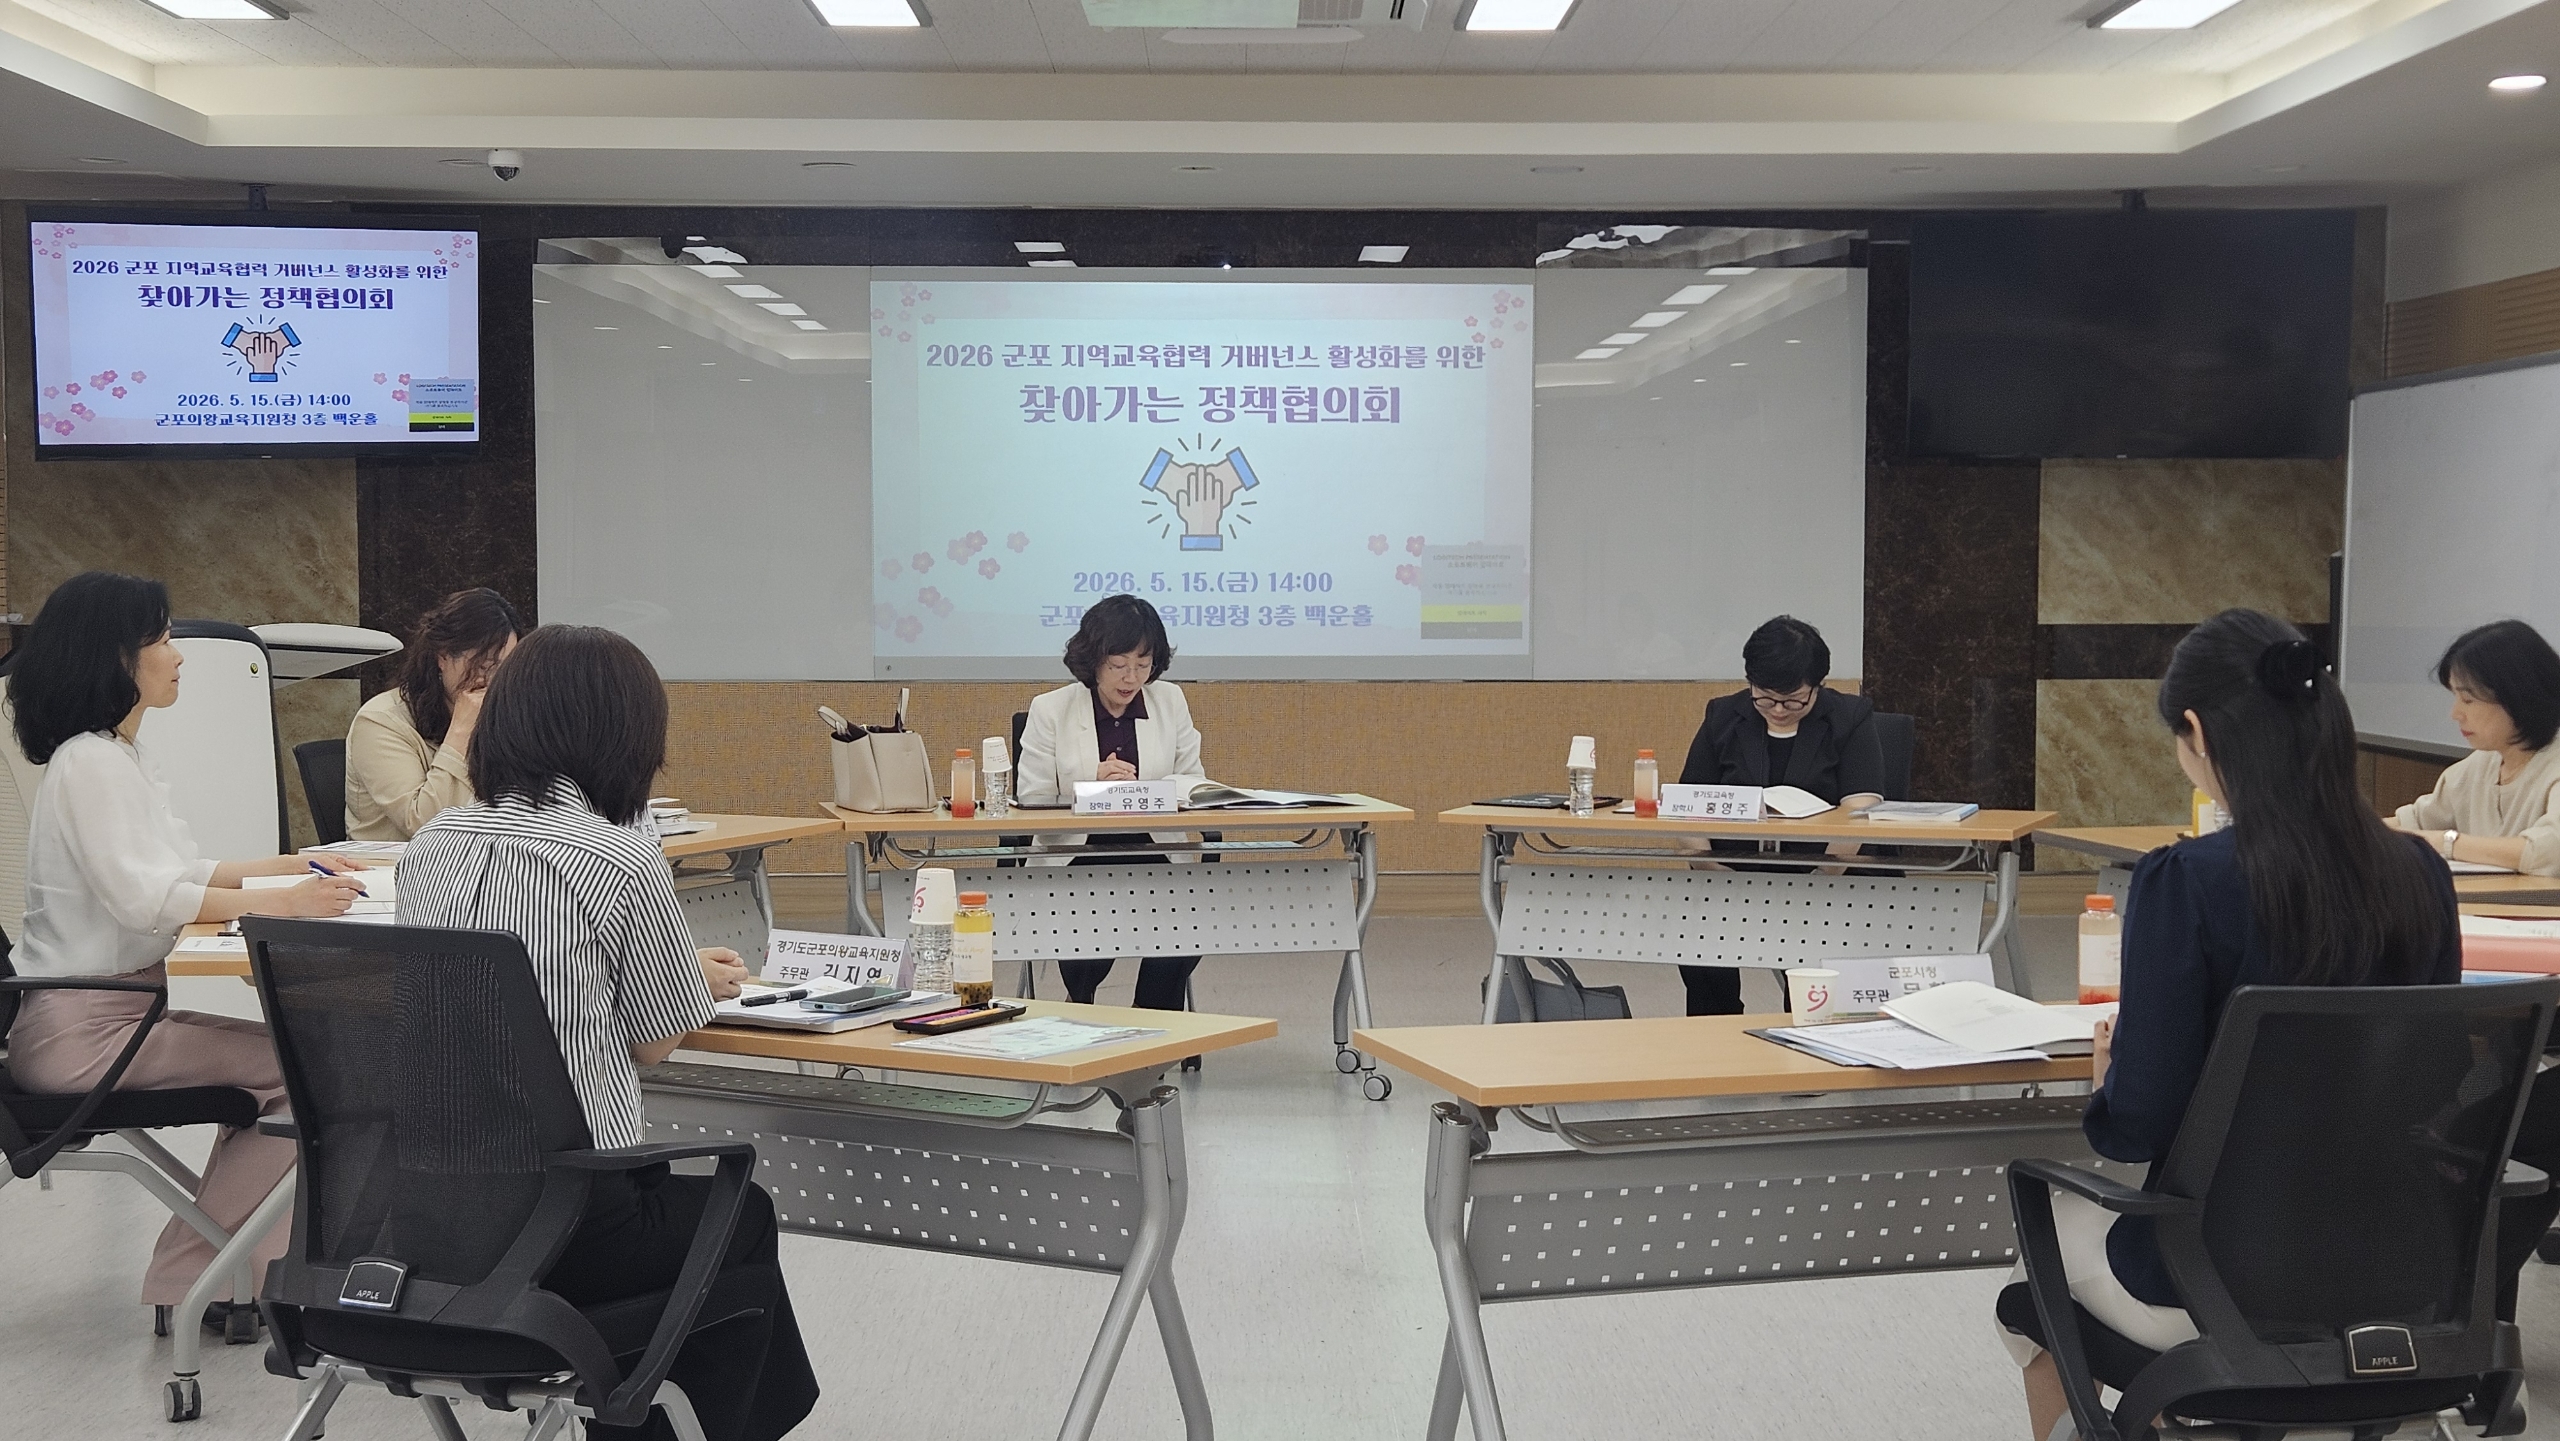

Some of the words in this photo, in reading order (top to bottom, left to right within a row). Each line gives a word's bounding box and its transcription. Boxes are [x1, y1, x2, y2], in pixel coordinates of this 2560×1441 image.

[72, 260, 119, 274] 2026
[124, 260, 160, 275] 군포
[165, 261, 268, 277] 지역교육협력
[273, 262, 341, 278] 거버넌스
[344, 263, 411, 279] 활성화를
[415, 265, 449, 280] 위한
[137, 284, 251, 309] 찾아가는
[259, 286, 394, 310] 정책협의회
[925, 344, 994, 368] 2026
[1001, 344, 1053, 368] 군포
[1060, 344, 1211, 369] 지역교육협력
[1220, 345, 1321, 369] 거버넌스
[1327, 344, 1428, 369] 활성화를
[1435, 345, 1487, 369] 위한
[177, 393, 224, 407] 2026.
[229, 393, 245, 407] 5.
[250, 393, 303, 407] 15.(금)
[308, 393, 352, 407] 14:00
[1019, 384, 1185, 424] 찾아가는
[1198, 385, 1401, 424] 정책협의회
[154, 412, 297, 427] 군포의왕교육지원청
[302, 413, 328, 427] 3층
[332, 412, 379, 427] 백운홀
[1073, 571, 1142, 593] 2026.
[1150, 571, 1172, 593] 5.
[1181, 571, 1259, 593] 15.(금)
[1267, 571, 1333, 593] 14:00
[1039, 604, 1250, 628] 군포육지원청
[1257, 604, 1297, 628] 3층
[1303, 604, 1374, 628] 백운홀
[1692, 790, 1735, 799] 경기도교육청
[1089, 801, 1112, 811] 장학관
[1671, 803, 1694, 813] 장학사
[776, 940, 901, 963] 경기도군포의왕교육지원청
[779, 965, 810, 981] 주무관
[1888, 966, 1937, 979] 군포시청
[1852, 989, 1890, 1003] 주무관
[355, 1289, 381, 1300] APPLE
[2371, 1356, 2399, 1367] APPLE
